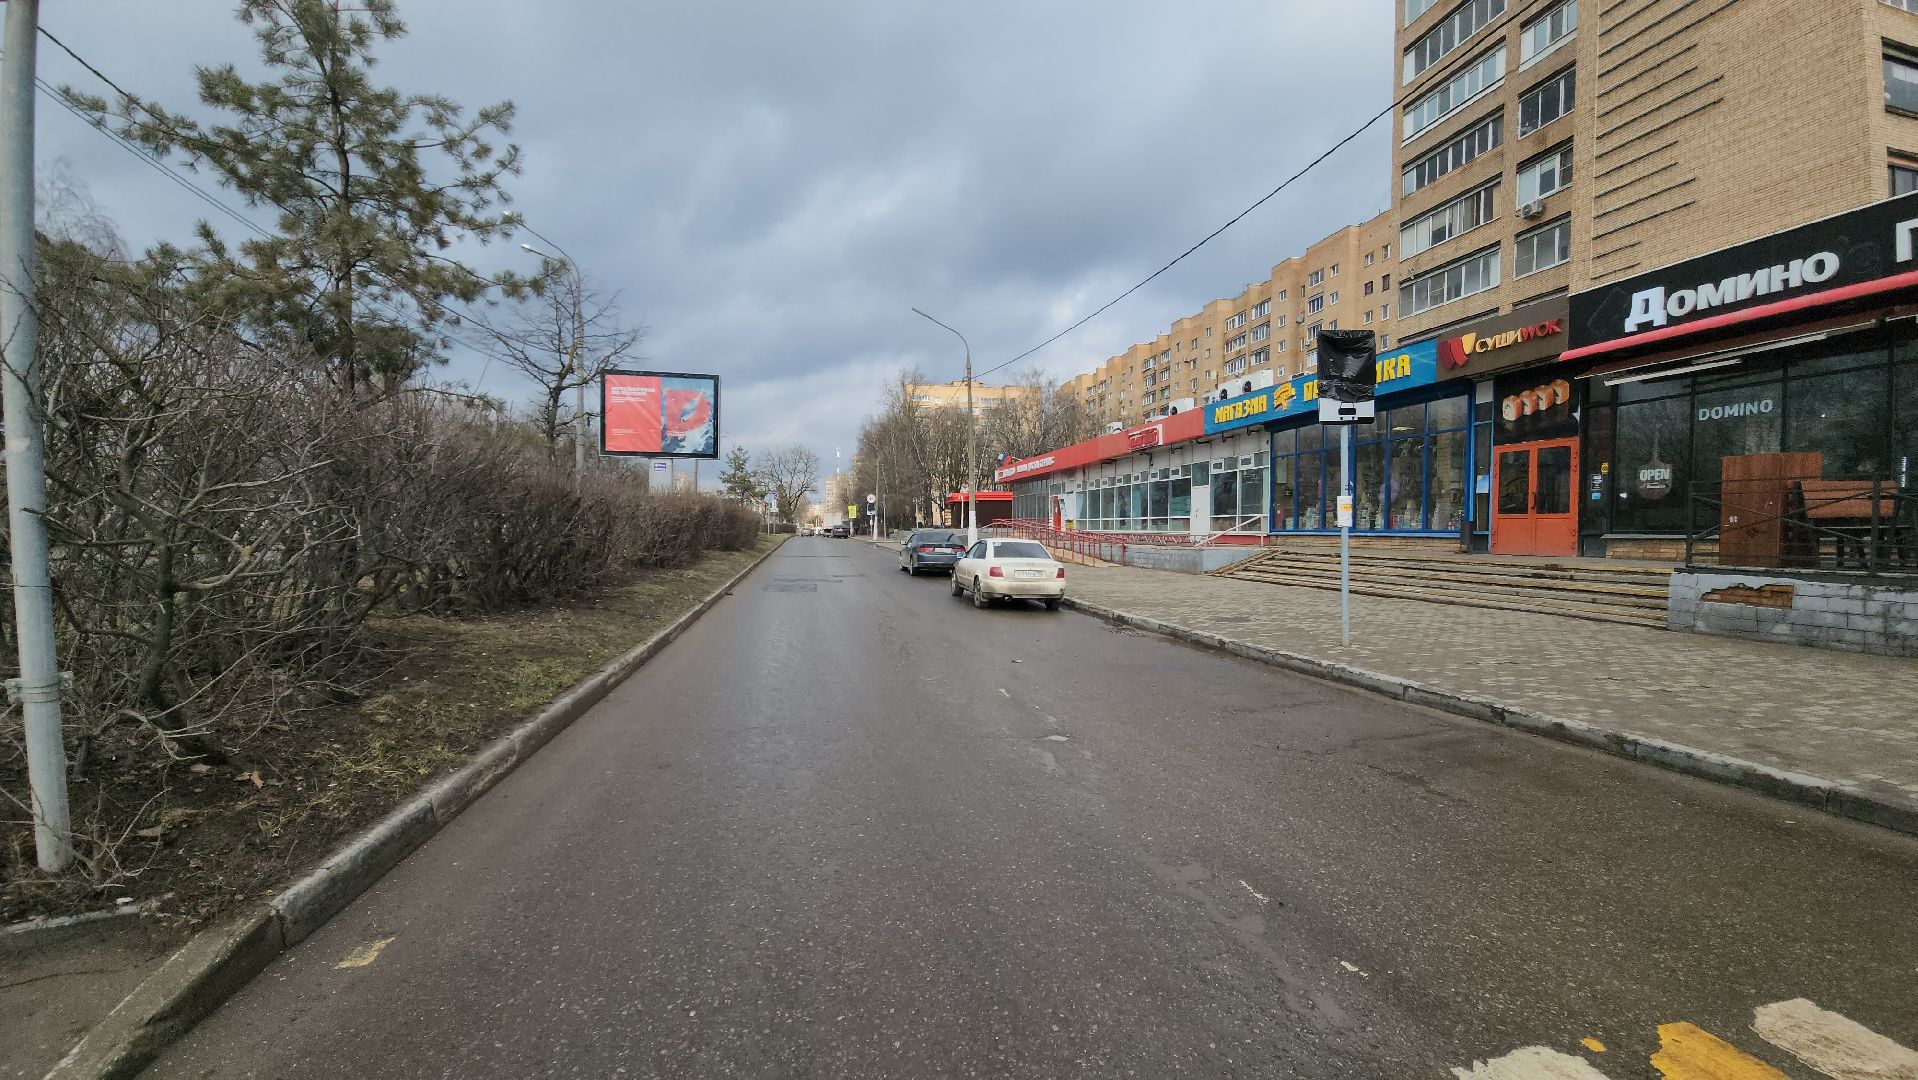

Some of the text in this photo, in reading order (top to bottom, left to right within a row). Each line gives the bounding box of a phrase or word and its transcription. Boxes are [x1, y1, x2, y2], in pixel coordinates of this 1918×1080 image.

[1215, 394, 1268, 424] МАГАЗИН
[1698, 399, 1774, 421] DOMINO
[1639, 468, 1670, 481] OPEN
